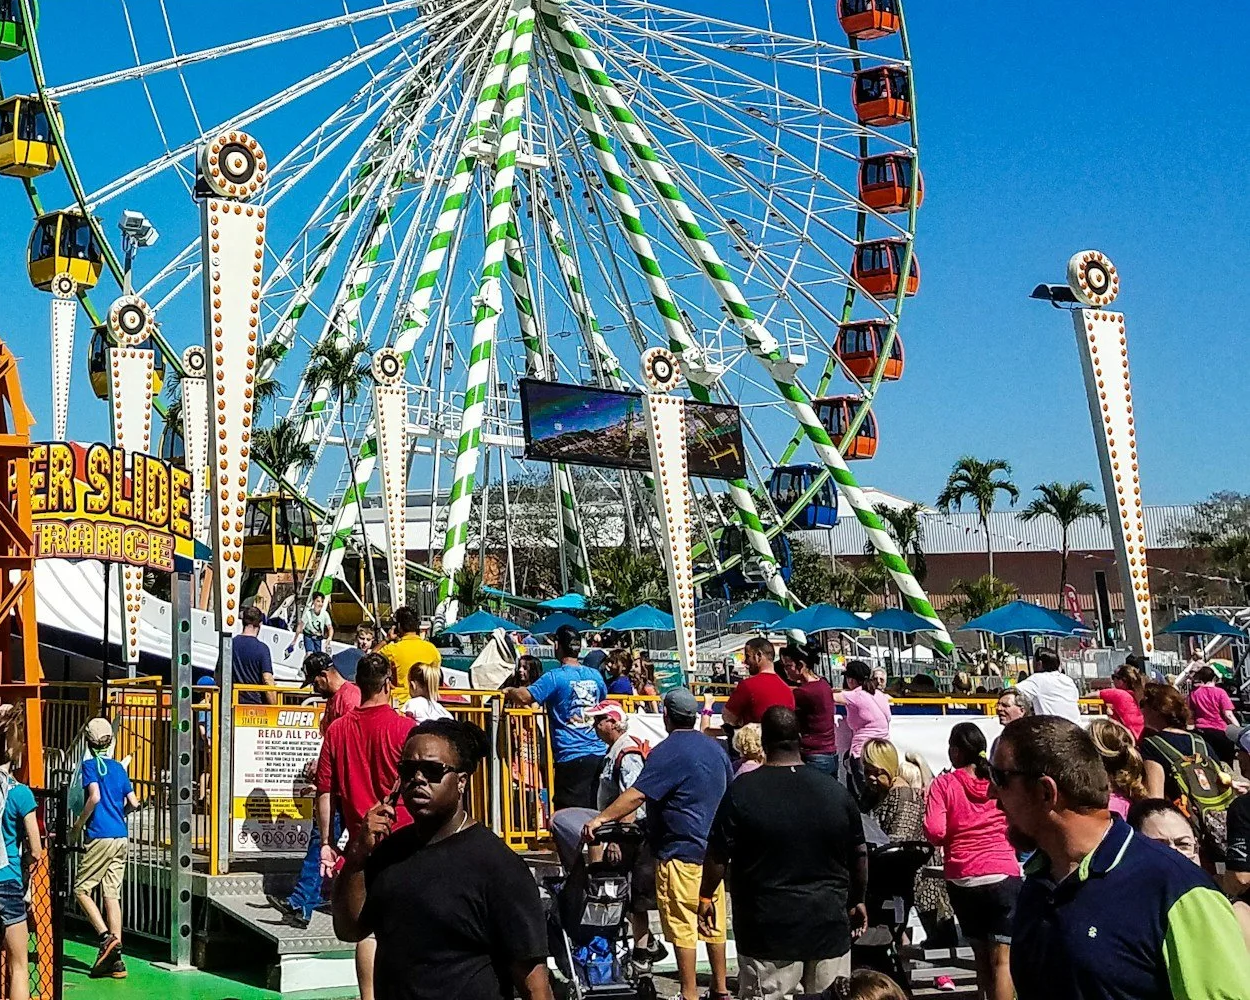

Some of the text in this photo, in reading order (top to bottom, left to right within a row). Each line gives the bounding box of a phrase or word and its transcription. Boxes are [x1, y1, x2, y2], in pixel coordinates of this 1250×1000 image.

[85, 442, 193, 540] SLIDE
[125, 696, 155, 705] ENTE
[277, 710, 315, 727] SUPER
[258, 729, 323, 740] READ ALL POS
